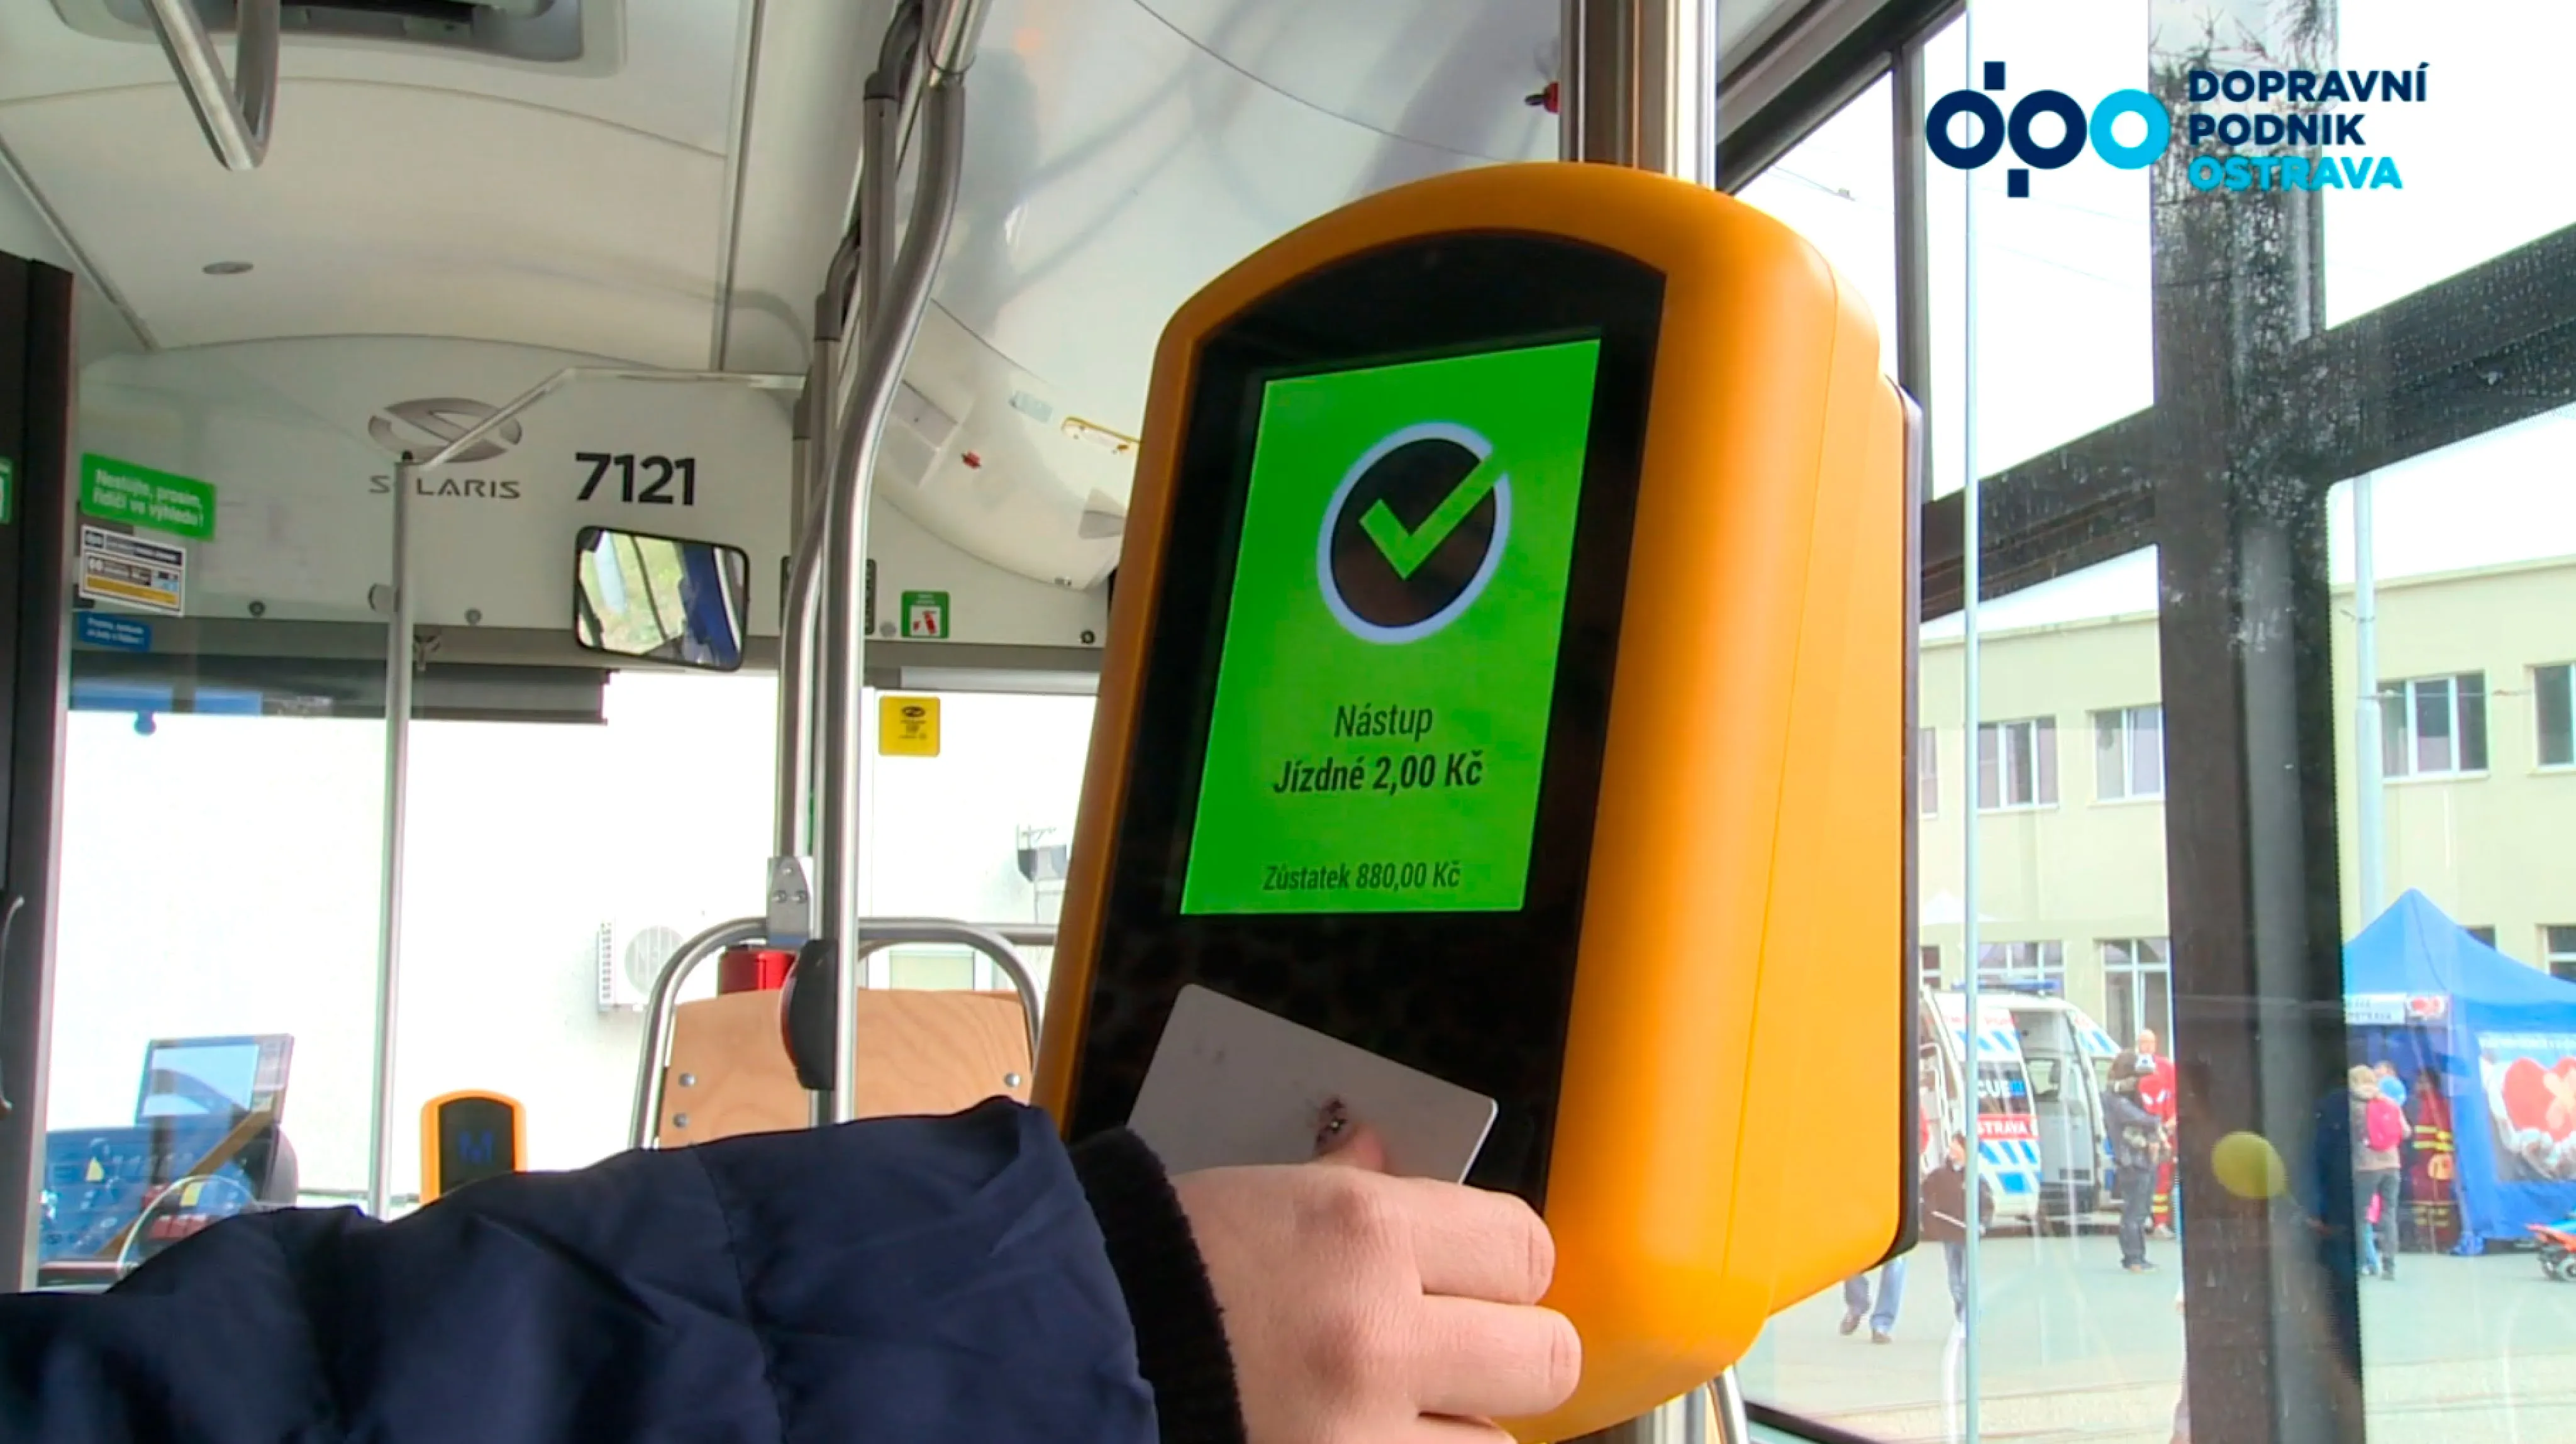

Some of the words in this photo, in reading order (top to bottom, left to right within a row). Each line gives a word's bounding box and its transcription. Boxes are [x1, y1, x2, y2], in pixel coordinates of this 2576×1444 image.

[369, 474, 521, 500] SLARIS
[575, 452, 696, 506] 7121
[1333, 702, 1433, 743] Nástup
[1272, 755, 1365, 794] Jízdné
[1372, 753, 1437, 797] 2,00
[1444, 749, 1484, 787] Kč
[1263, 862, 1351, 891] Zůstatek
[1355, 862, 1428, 891] 880,00
[1431, 860, 1460, 888] Kč
[1977, 1120, 2028, 1135] STRAVA
